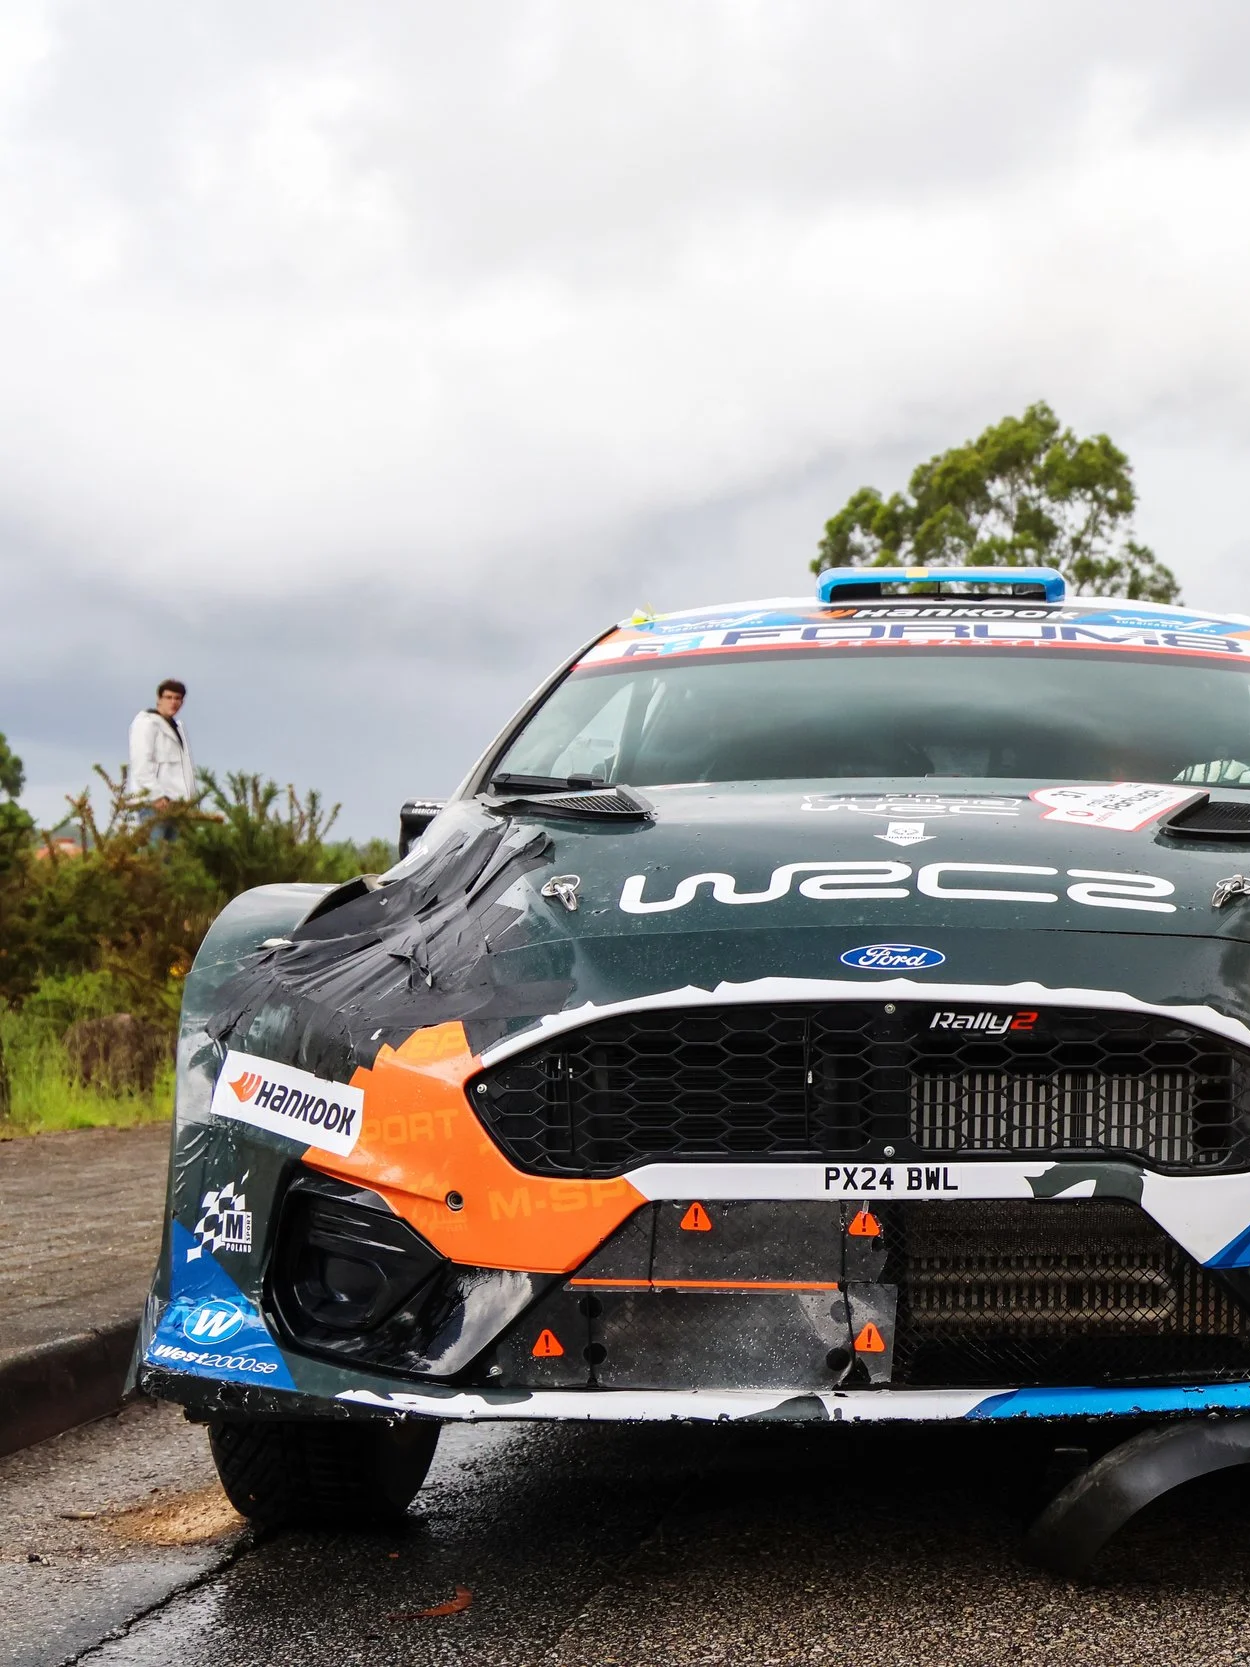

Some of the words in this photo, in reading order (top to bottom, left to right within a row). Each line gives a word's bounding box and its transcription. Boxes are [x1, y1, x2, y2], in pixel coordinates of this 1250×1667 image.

[721, 623, 1243, 653] FORUM8
[619, 861, 1177, 914] WRC2
[858, 946, 926, 967] Ford
[929, 1011, 1039, 1035] Rally2
[825, 1167, 894, 1190] PX24
[907, 1167, 958, 1190] BWL
[225, 1213, 244, 1240] M
[226, 1243, 252, 1253] POLAND
[154, 1344, 278, 1374] West2000.se
